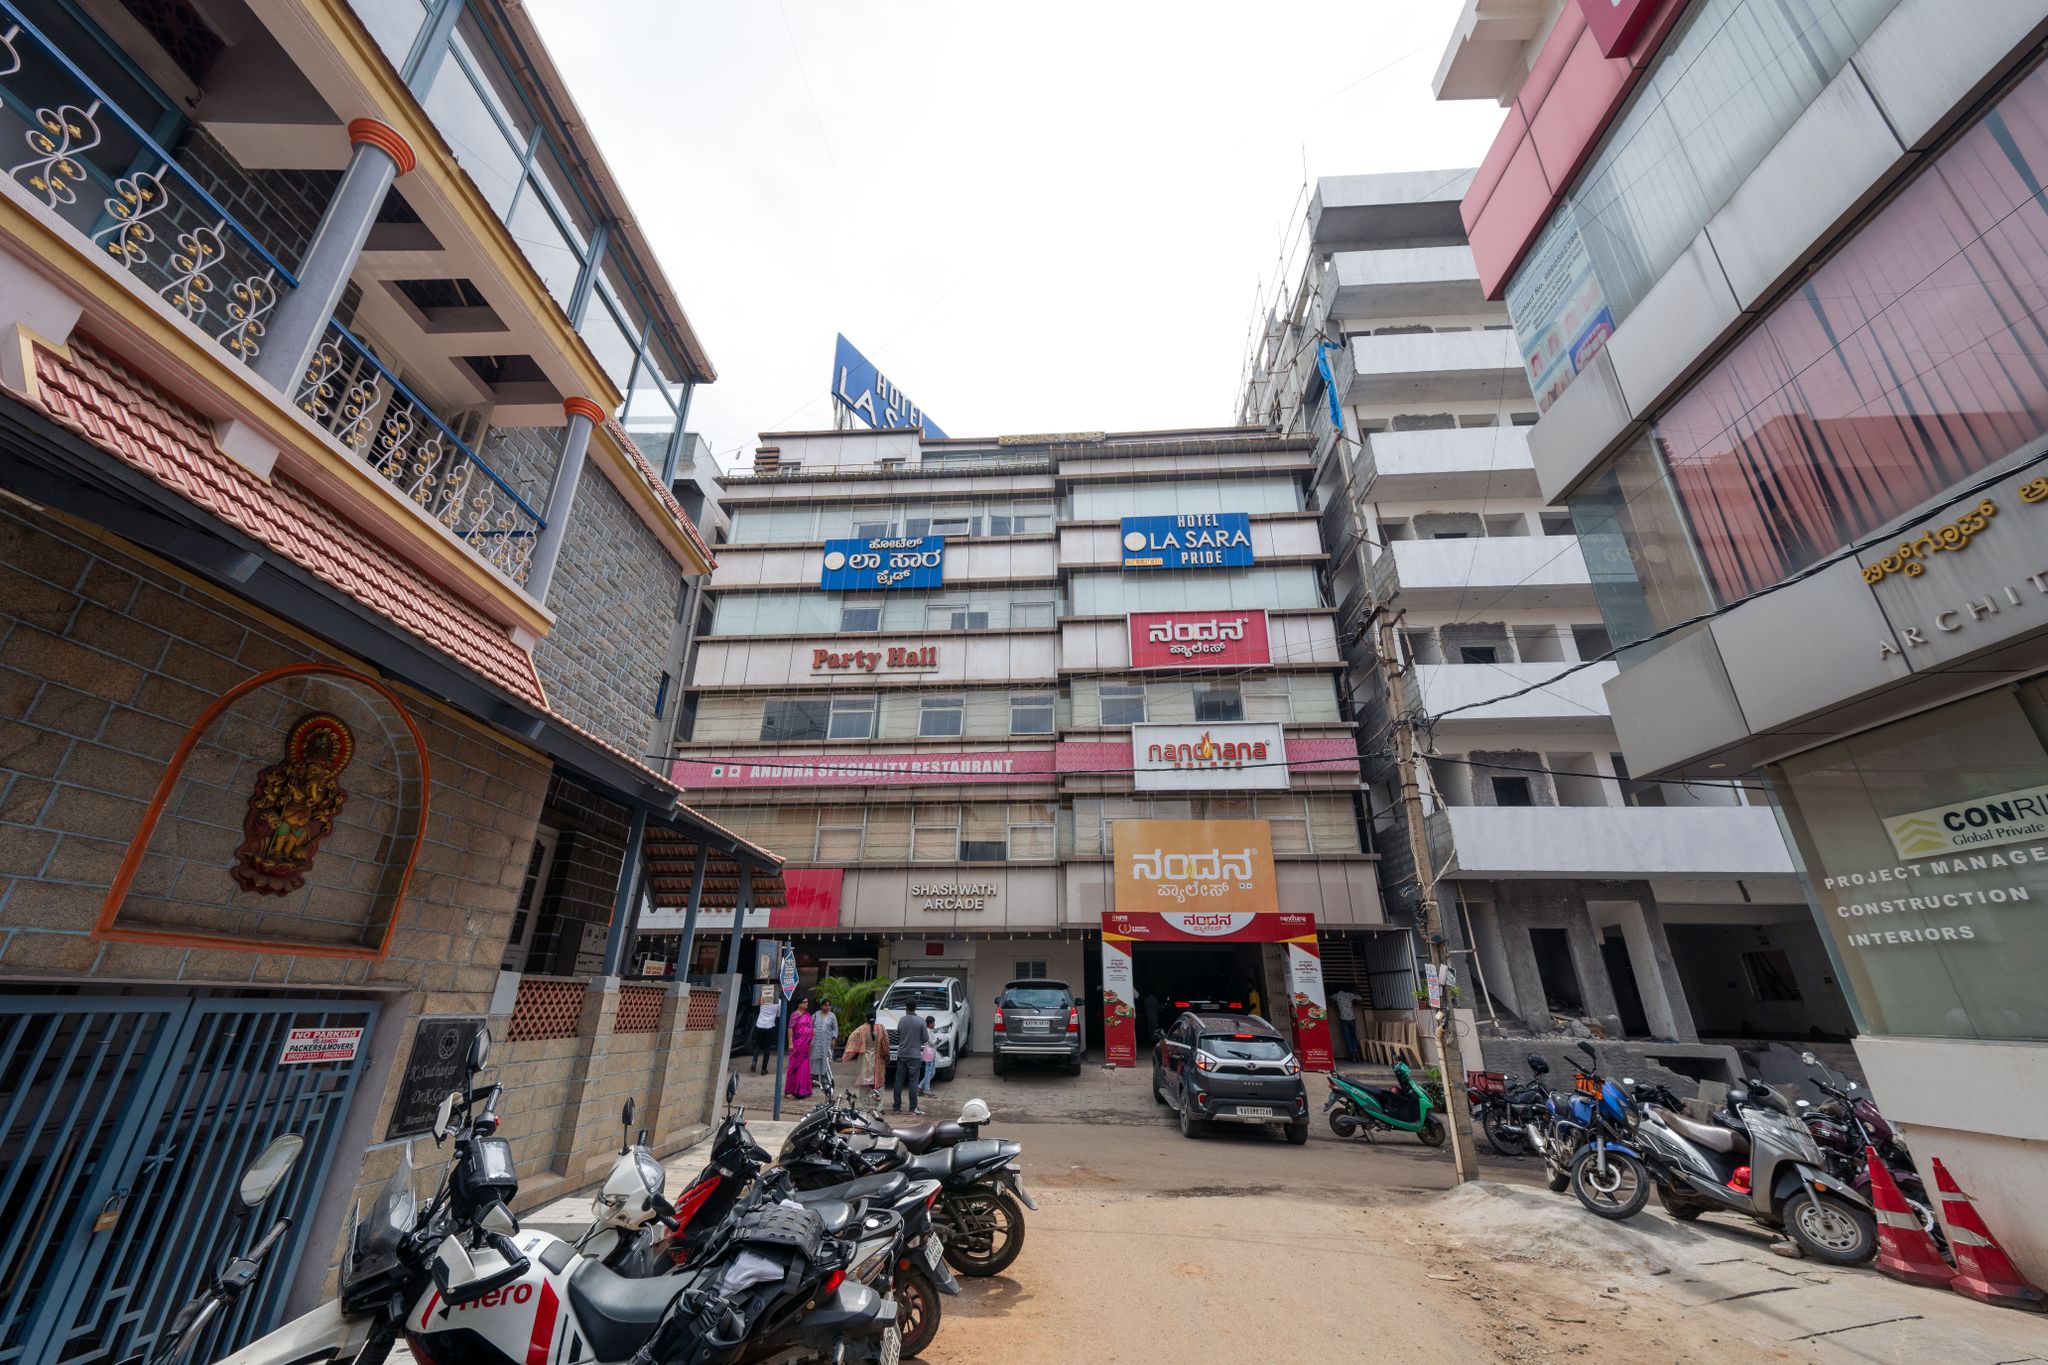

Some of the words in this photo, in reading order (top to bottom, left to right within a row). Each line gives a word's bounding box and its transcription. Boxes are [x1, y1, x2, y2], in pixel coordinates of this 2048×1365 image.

[1514, 295, 1535, 324] Contact
[1178, 514, 1219, 527] HOTEL
[1150, 532, 1180, 549] LA
[1185, 530, 1250, 548] SARA
[890, 549, 941, 568] ಸಾರ
[1181, 551, 1222, 565] PRIDE
[1149, 619, 1244, 642] ನಂದನ
[812, 648, 881, 671] Party
[887, 647, 937, 667] Hall
[750, 763, 813, 777] ANDHRA
[817, 762, 907, 777] SPECIALITY
[912, 759, 1013, 776] RESTAURANT
[1952, 827, 1994, 846] Global
[1996, 823, 2046, 839] Private
[1132, 848, 1254, 880] ನಂದನ
[1824, 865, 1921, 889] PROJECT
[911, 884, 997, 897] SHASHWATH
[923, 898, 984, 911] ARCADE
[1837, 886, 2031, 918] CONSTRUCTION
[1183, 914, 1232, 926] ನಂದನ
[1848, 926, 1976, 947] INTERIORS
[295, 1031, 311, 1039] NO
[313, 1030, 357, 1039] PARKING
